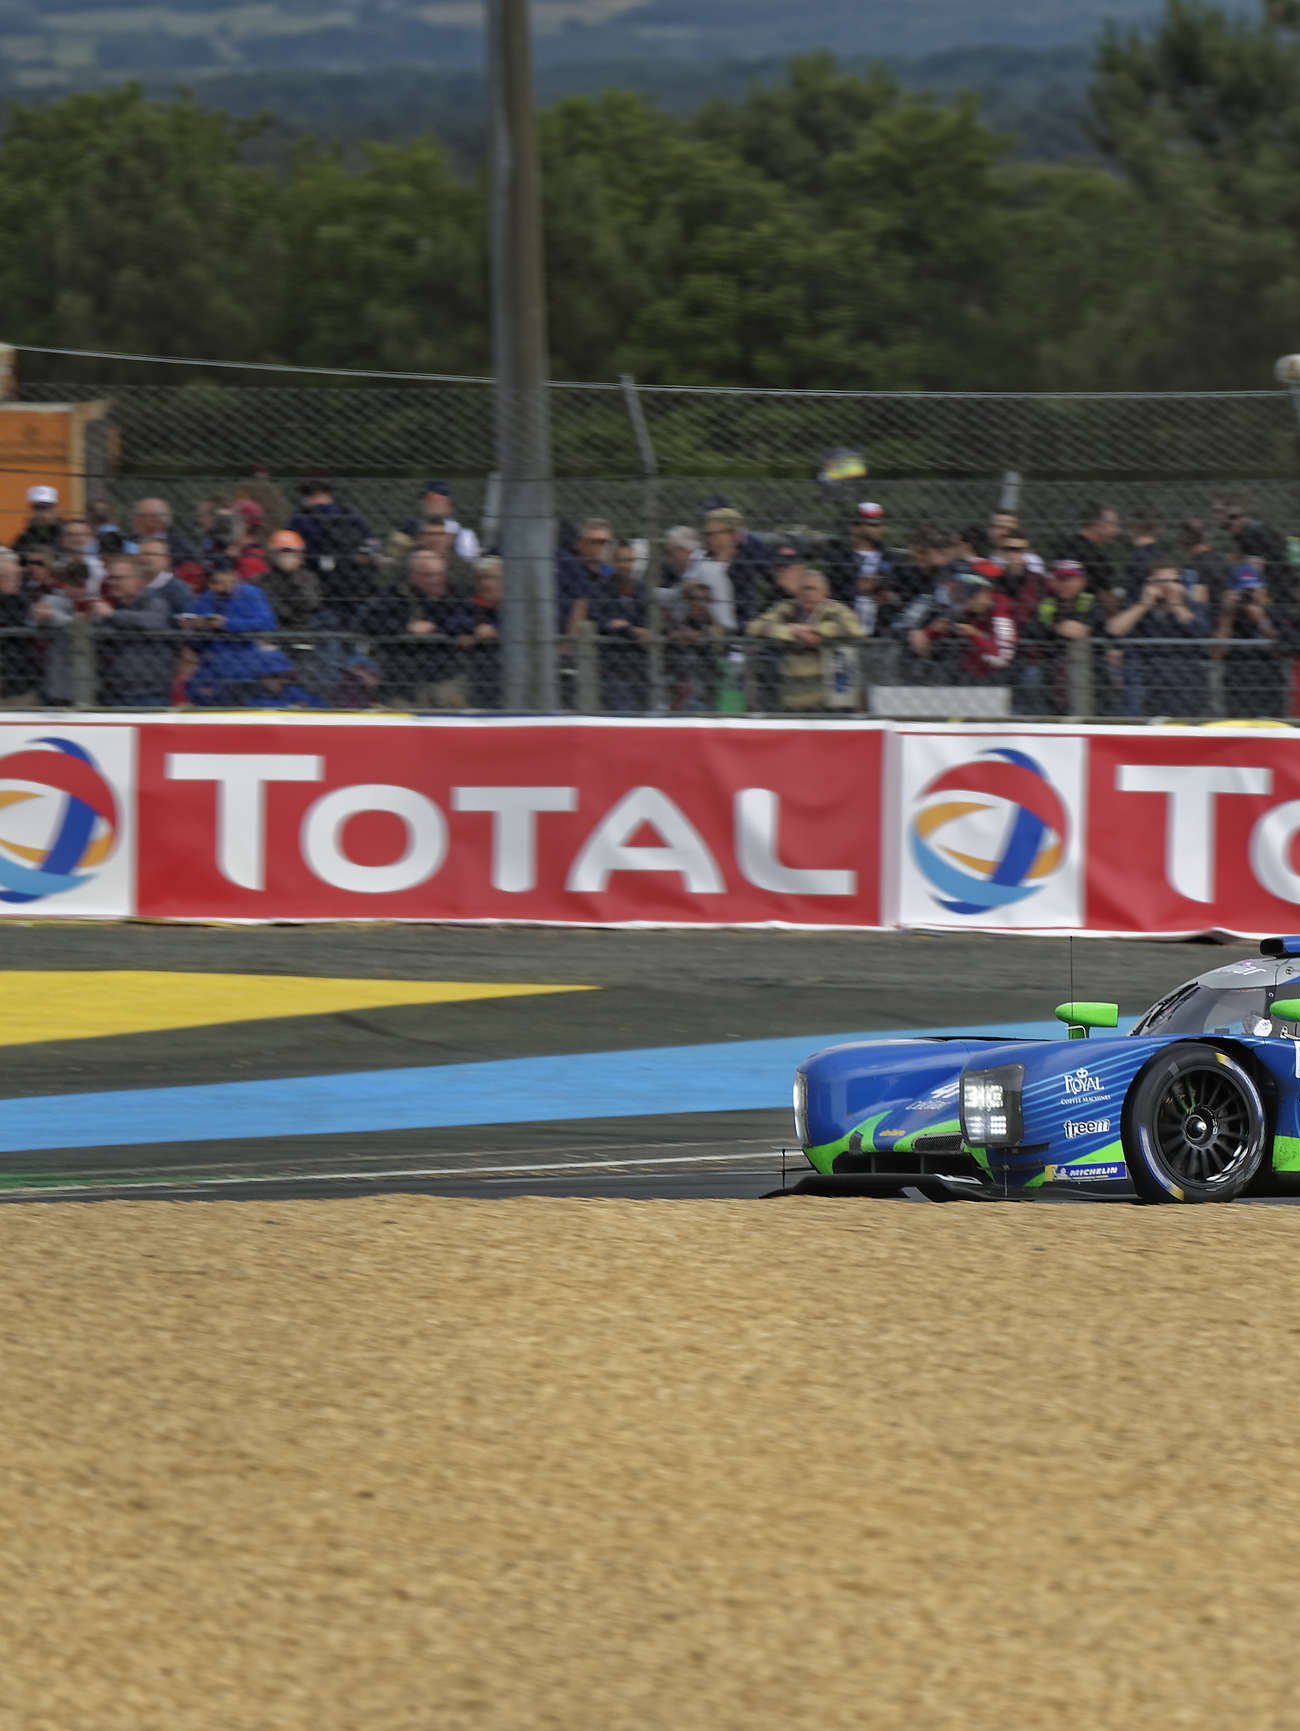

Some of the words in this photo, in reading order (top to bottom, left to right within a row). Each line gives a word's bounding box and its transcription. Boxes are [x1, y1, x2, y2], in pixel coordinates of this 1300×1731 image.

[165, 752, 859, 897] TOTAL
[1064, 1119, 1110, 1138] freem
[1069, 1166, 1119, 1177] MICHELIN
